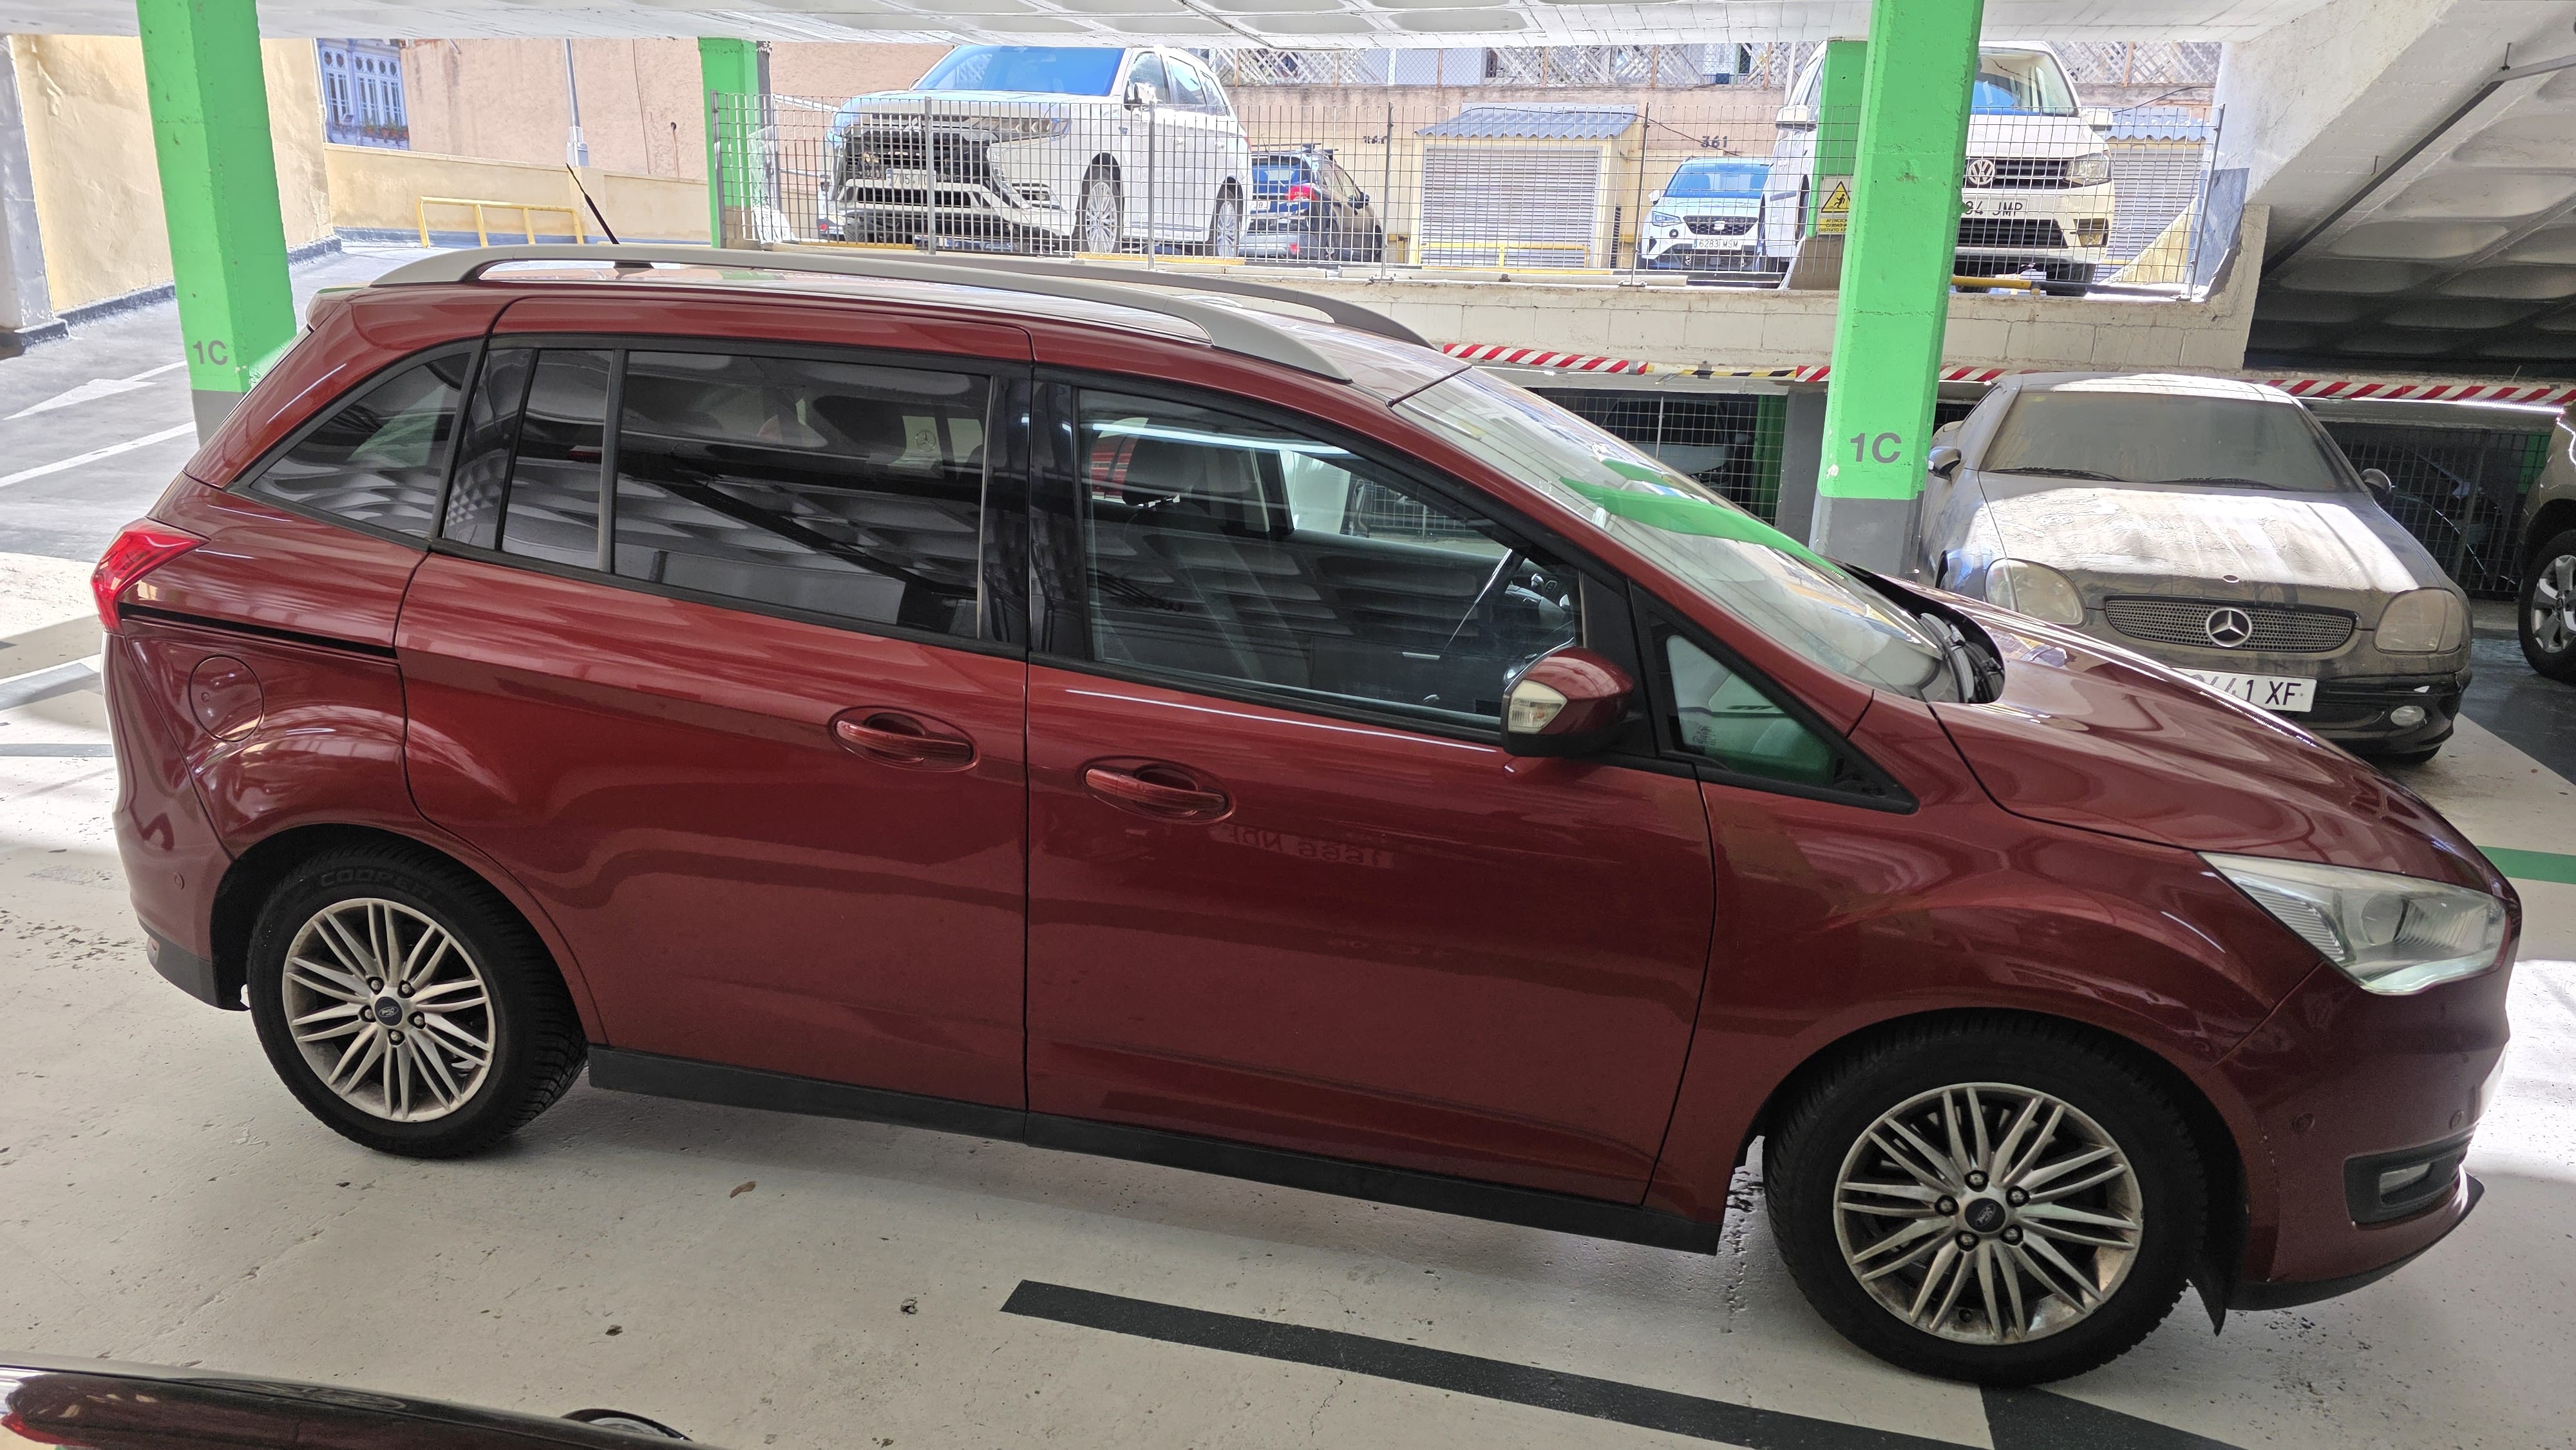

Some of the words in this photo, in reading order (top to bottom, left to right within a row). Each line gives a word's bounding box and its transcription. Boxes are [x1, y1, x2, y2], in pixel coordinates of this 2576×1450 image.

[1700, 135, 1728, 148] 361
[1992, 202, 2023, 216] JMP
[1699, 239, 1719, 248] 6283
[1722, 240, 1738, 248] MSM
[192, 339, 228, 366] 1C
[1850, 432, 1902, 464] 1C
[2265, 681, 2302, 706] XF
